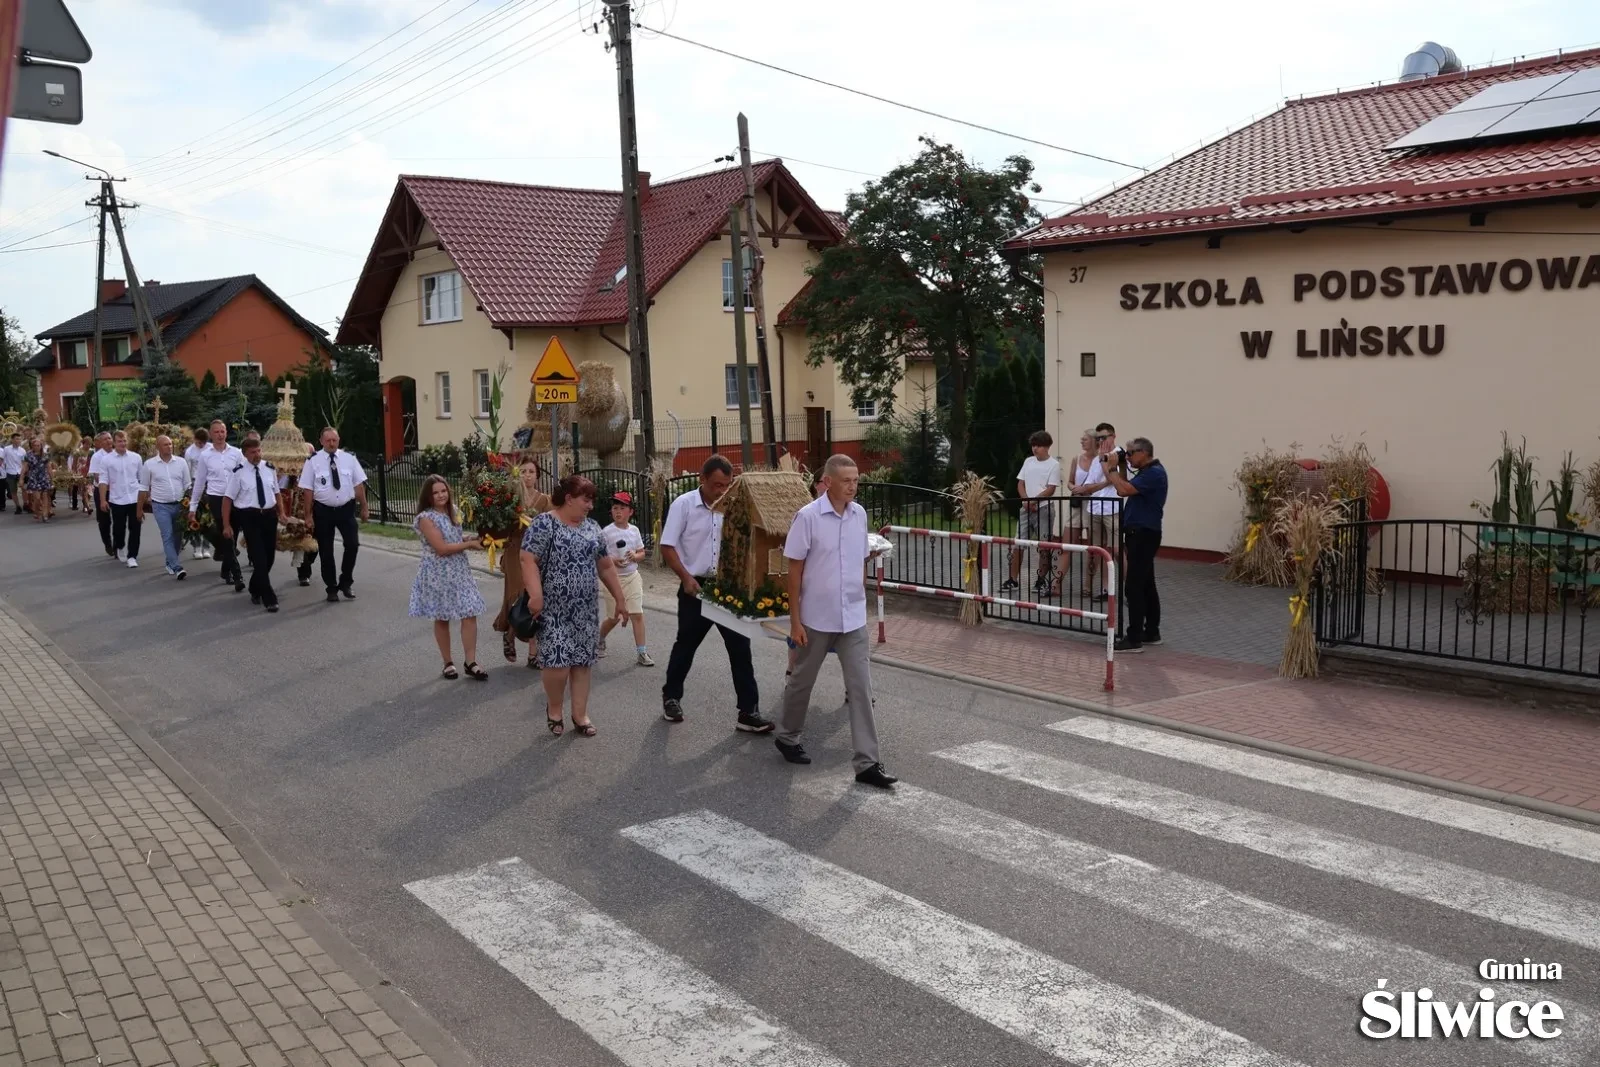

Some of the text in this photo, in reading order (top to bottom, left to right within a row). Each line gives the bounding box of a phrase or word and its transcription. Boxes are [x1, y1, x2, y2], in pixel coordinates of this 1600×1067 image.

[1069, 266, 1087, 284] 37
[1119, 254, 1600, 311] SZKOŁA PODSTAWOWA
[1240, 318, 1445, 359] W LIŃSKU
